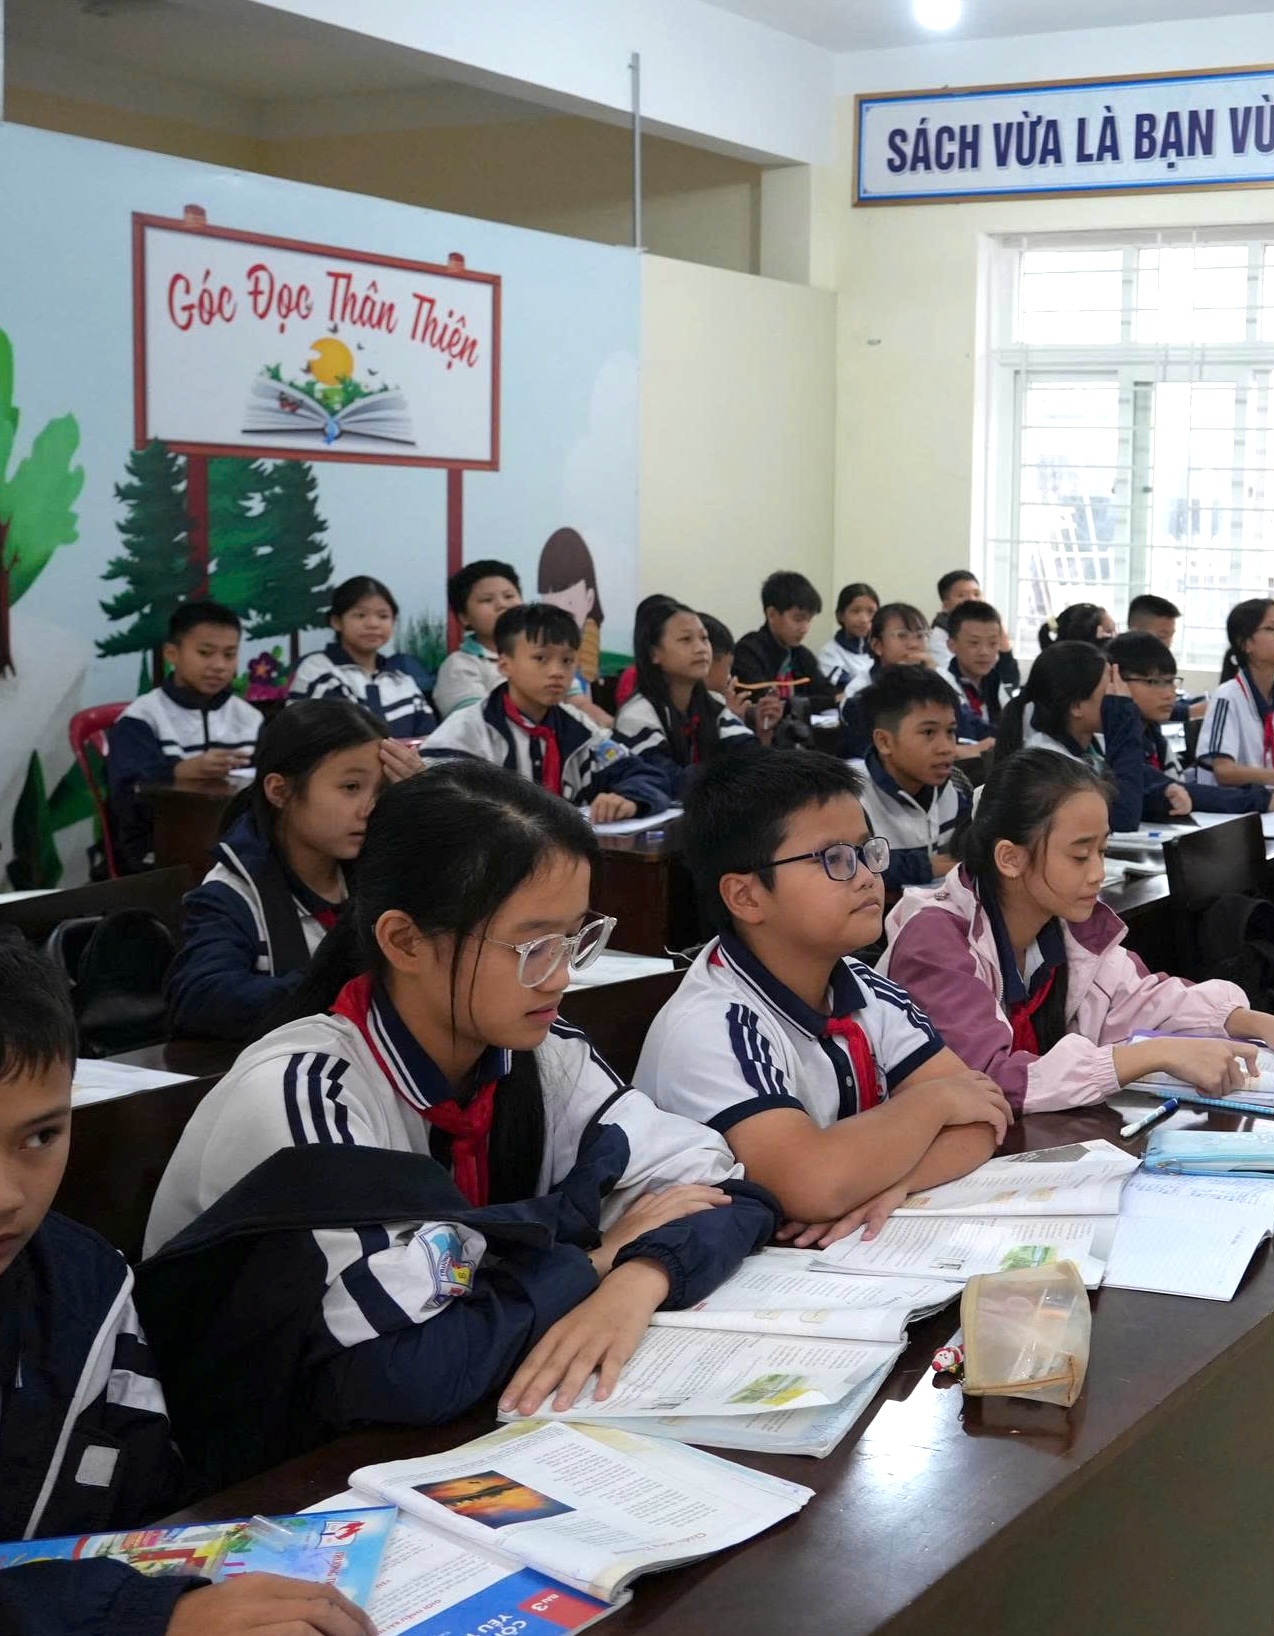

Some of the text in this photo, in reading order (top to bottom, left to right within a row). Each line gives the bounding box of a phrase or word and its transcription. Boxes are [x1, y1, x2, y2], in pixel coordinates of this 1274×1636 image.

[887, 118, 980, 173] SÁCH
[993, 111, 1062, 167] VỪA
[1076, 106, 1120, 163] LÀ
[1134, 109, 1215, 169] BẠN
[168, 263, 480, 371] Góc Đọc Thân Thiện
[531, 1602, 549, 1612] 3
